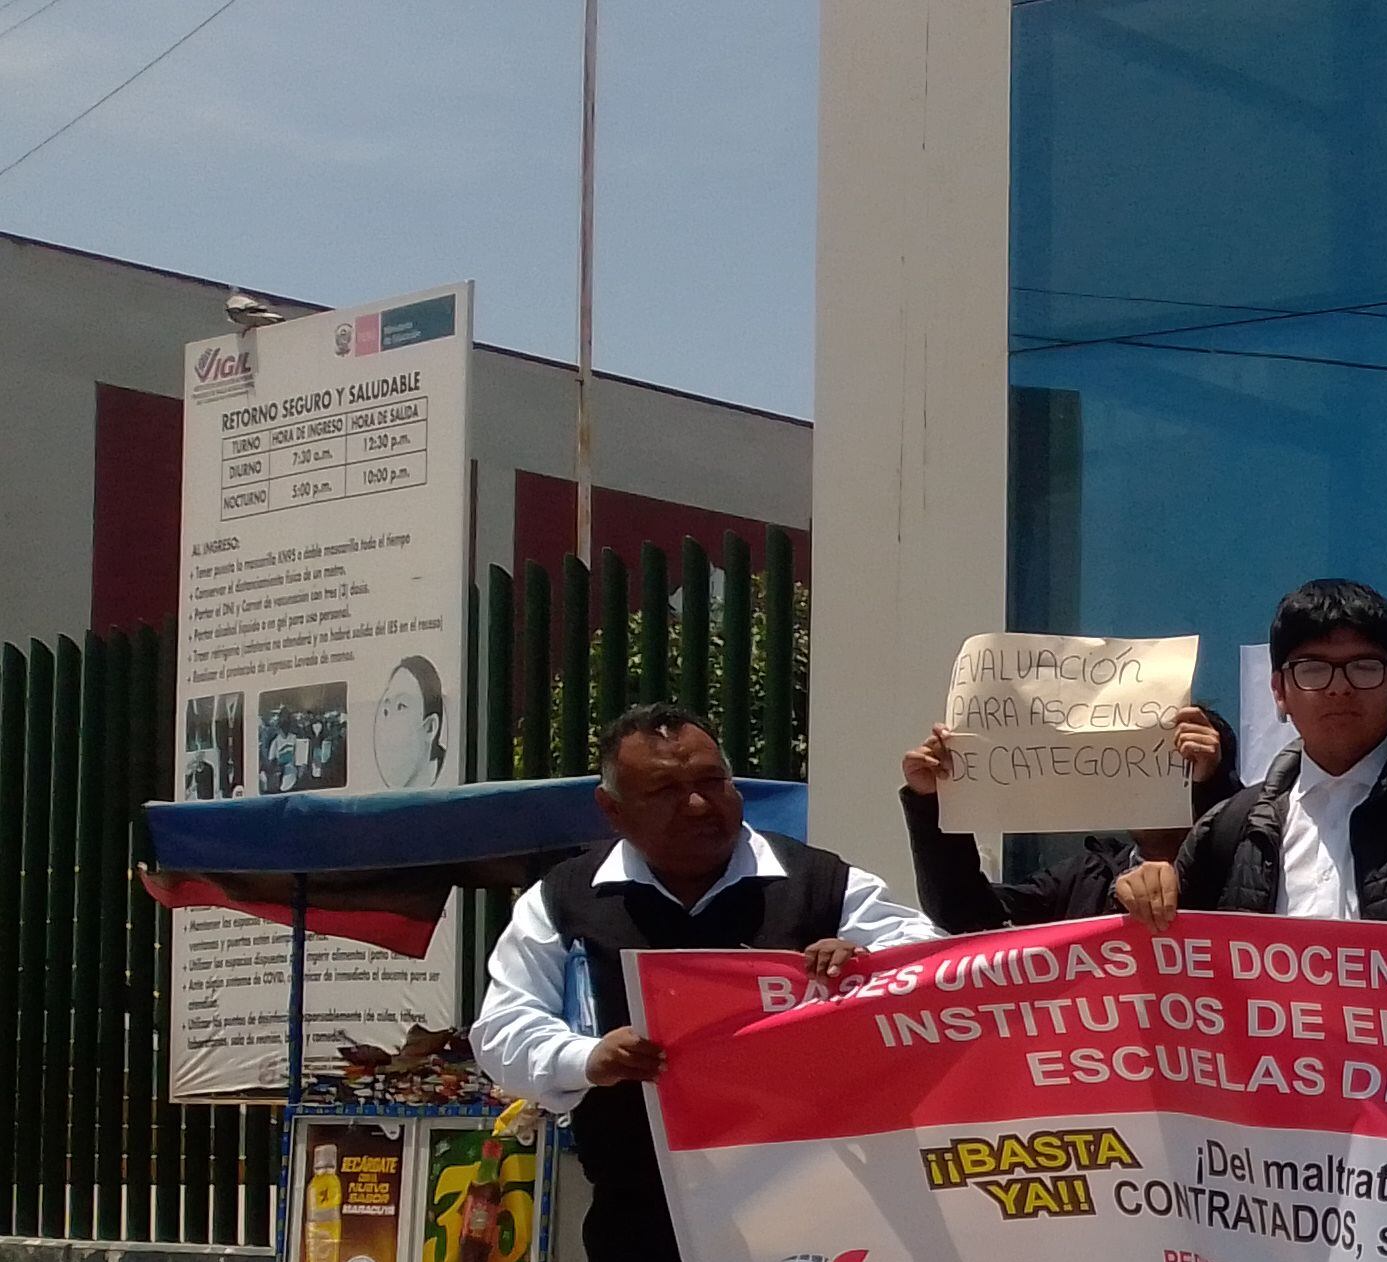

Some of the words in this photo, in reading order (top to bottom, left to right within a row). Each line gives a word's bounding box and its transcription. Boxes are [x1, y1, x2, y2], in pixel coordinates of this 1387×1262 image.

[193, 347, 252, 383] VIGIL
[221, 402, 278, 432] RETORNO
[281, 390, 332, 418] SEGURO
[335, 387, 345, 406] Y
[348, 371, 421, 405] SALUDABLE
[231, 436, 261, 452] TURNO
[271, 428, 295, 447] HORA
[296, 425, 306, 441] DE
[307, 418, 344, 438] INGRESO
[350, 411, 376, 430] HORA
[377, 408, 388, 424] DE
[389, 403, 419, 423] SALIDA
[228, 460, 263, 480] DIURNO
[292, 450, 312, 466] 7:30
[363, 434, 389, 452] 12:30
[391, 433, 412, 450] p.m.
[222, 489, 267, 511] NOCTURNO
[291, 482, 311, 499] 5:00
[312, 481, 333, 499] p.m.
[362, 467, 388, 485] 10:00
[390, 467, 411, 484] p.m.
[951, 695, 1020, 731] PARA
[1029, 696, 1178, 732] ASCENSO
[949, 748, 979, 784] DE
[988, 737, 1192, 788] CATEGORÍA!
[757, 964, 924, 1013] BASES
[934, 938, 1138, 993] UNIDAS
[1152, 937, 1216, 981] DE
[873, 991, 1225, 1050] INSTITUTOS
[1246, 998, 1327, 1042] DE
[1025, 1045, 1327, 1097] ESCUELAS
[1195, 1138, 1255, 1188] ¡Del
[986, 1175, 1097, 1221] YA!!
[1111, 1177, 1364, 1261] CONTRATADOS,
